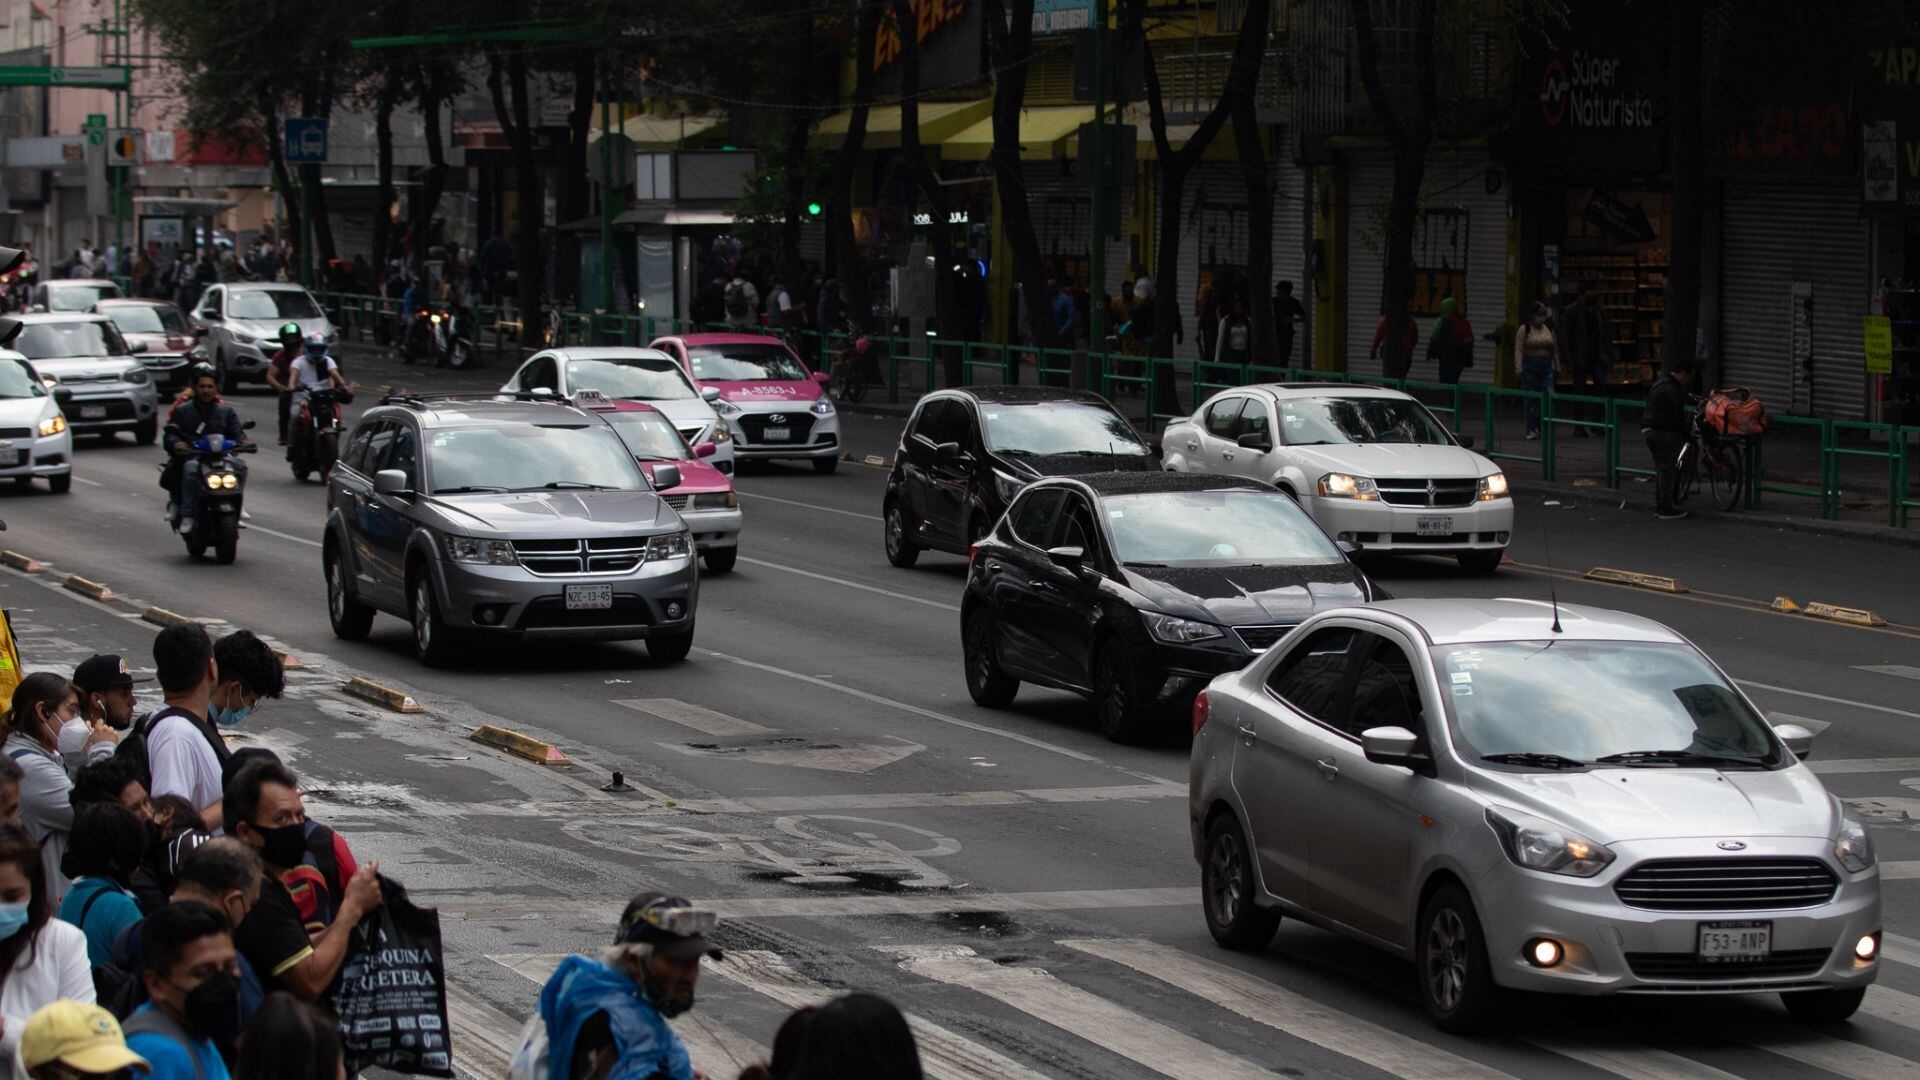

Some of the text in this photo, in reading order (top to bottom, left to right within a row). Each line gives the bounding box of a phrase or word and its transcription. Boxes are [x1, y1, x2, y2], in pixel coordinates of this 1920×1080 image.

[1570, 49, 1620, 94] Súper
[1569, 88, 1654, 128] Naturista
[578, 391, 600, 400] TAXI
[567, 590, 610, 603] NZC-13-45
[1702, 932, 1766, 951] F53-ANP
